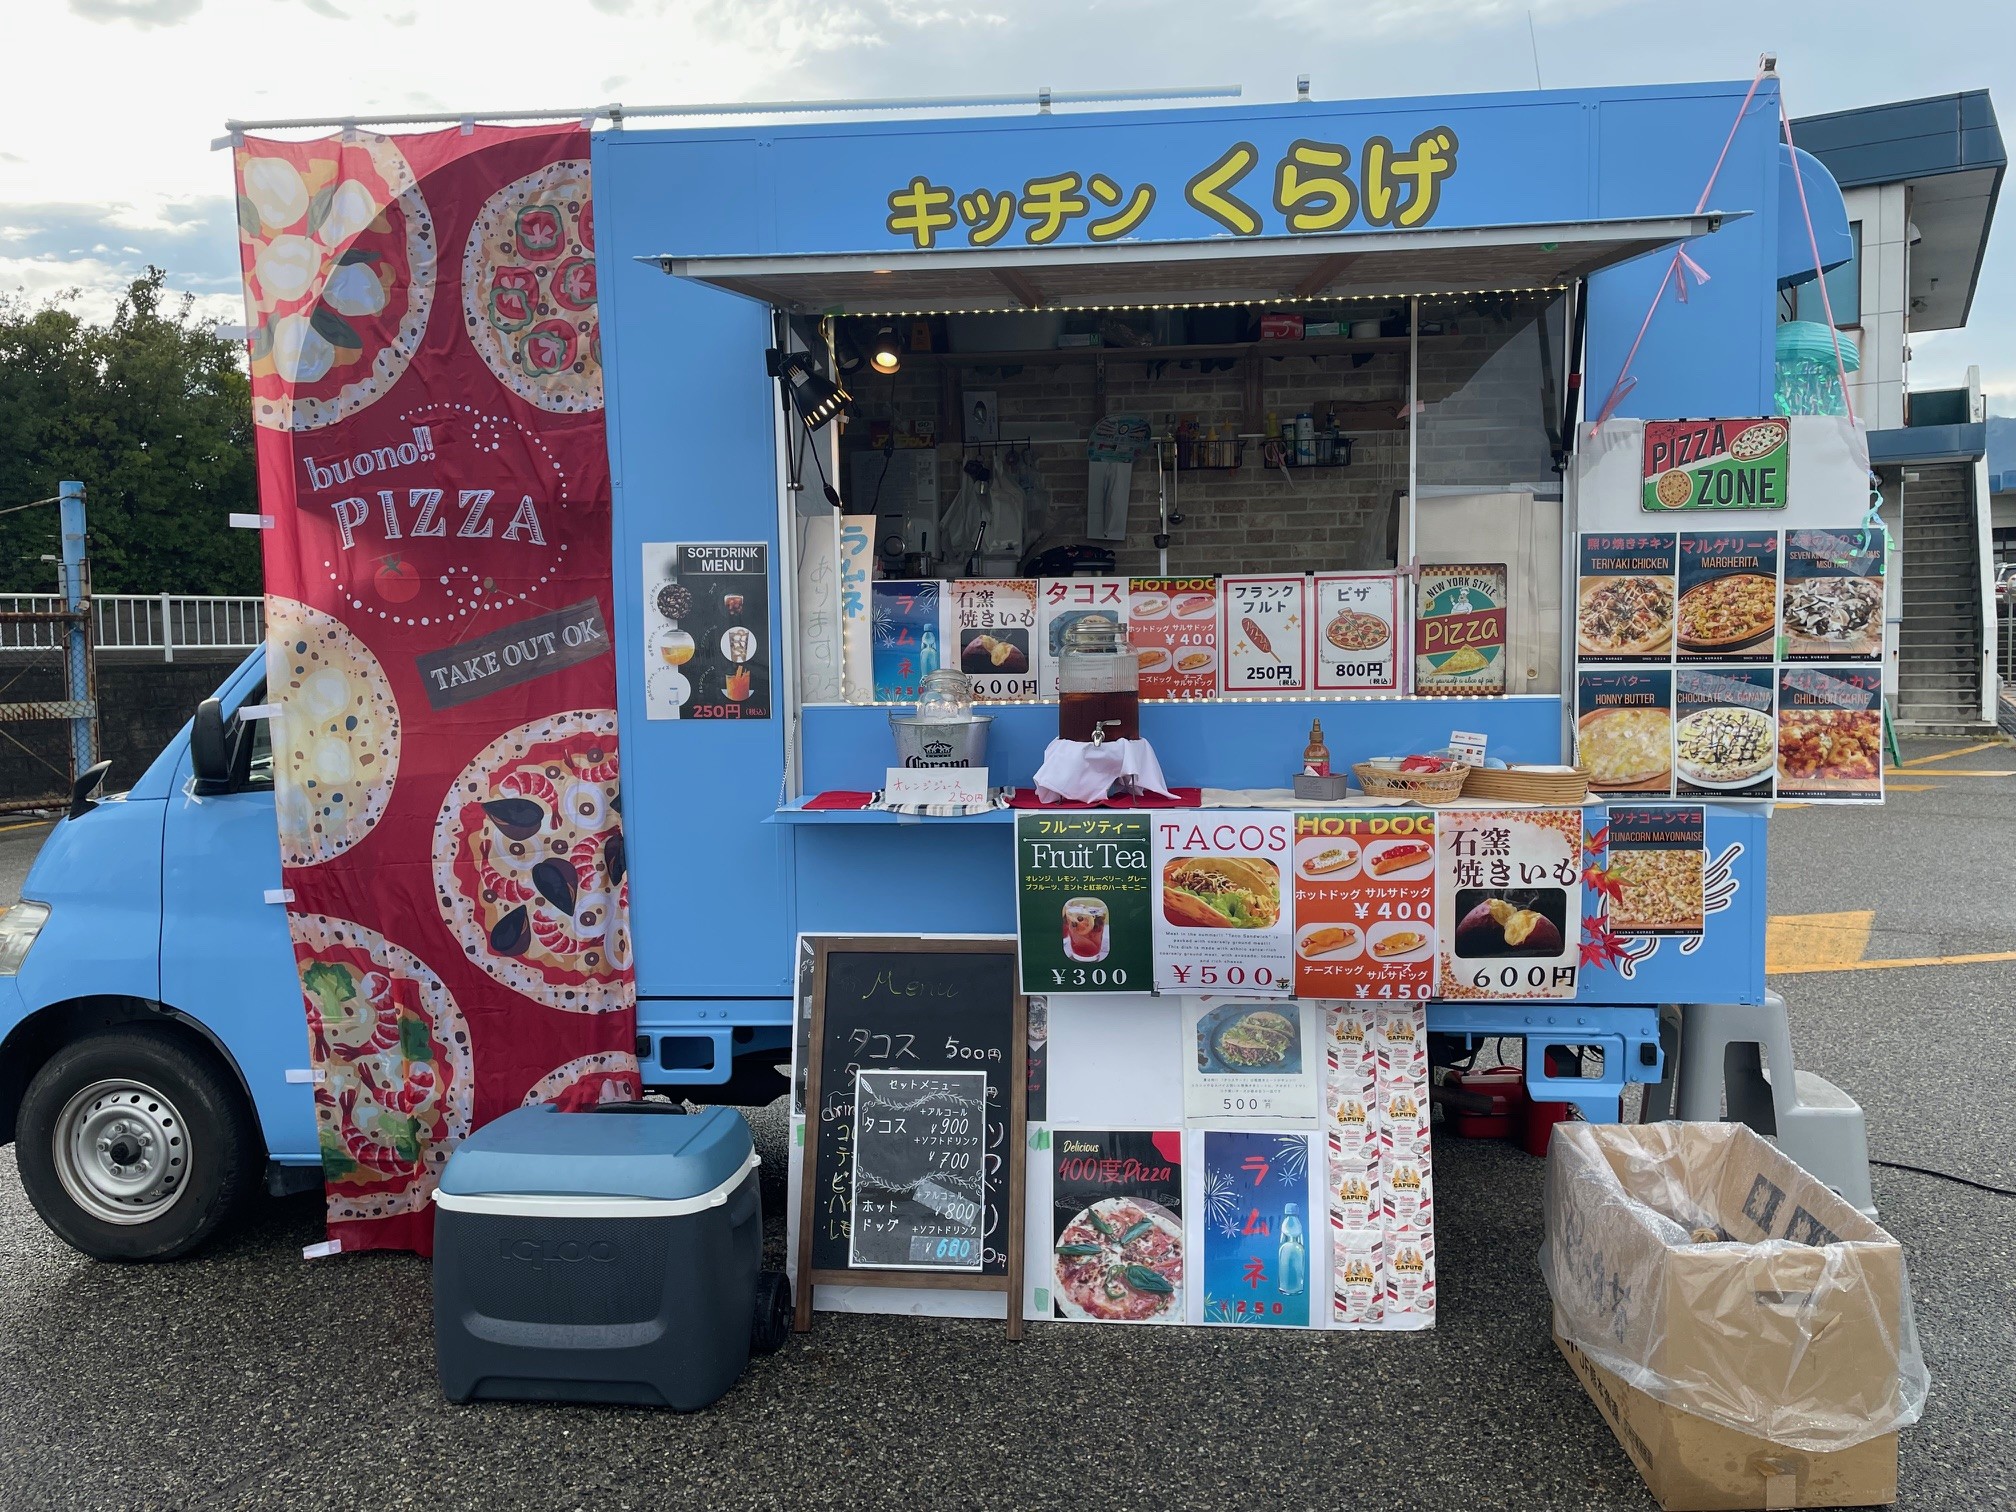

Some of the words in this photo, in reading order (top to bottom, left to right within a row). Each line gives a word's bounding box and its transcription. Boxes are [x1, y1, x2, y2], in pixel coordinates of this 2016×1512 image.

[887, 171, 1156, 249] キッチン
[1185, 125, 1459, 237] くらげ
[1652, 424, 1726, 474] PIZZA
[304, 426, 435, 491] buono!!
[1697, 467, 1777, 506] ZONE
[331, 488, 547, 550] PIZZA
[687, 547, 759, 559] SOFTDRINK
[1680, 539, 1777, 555] マルゲリータ
[1591, 558, 1630, 570] TERIYAKI
[1632, 557, 1669, 569] CHICKEN
[1700, 556, 1759, 568] MARGHERITA
[1789, 551, 1811, 560] SEVEN
[701, 559, 744, 572] MENU
[1129, 578, 1171, 591] HOT
[1235, 585, 1294, 599] フランク
[1426, 582, 1445, 599] NEW
[1446, 577, 1470, 588] YORK
[1472, 578, 1498, 598] STYLE
[956, 590, 995, 608] 石窯
[1046, 582, 1122, 605] タコス
[1337, 586, 1370, 602] ピザ
[1243, 600, 1287, 614] フルト
[958, 608, 1035, 628] 焼きいも
[1172, 624, 1215, 632] サルサドッグ
[896, 596, 915, 679] ラムネ
[429, 651, 501, 692] TAKE
[502, 632, 556, 668] OUT
[561, 617, 601, 649] OK
[1246, 664, 1293, 681] 250円
[1335, 662, 1383, 678] 800円
[1580, 674, 1651, 687] ハニーバター
[1595, 693, 1624, 705] HONNY
[1624, 692, 1655, 704] BUTTER
[1677, 692, 1723, 703] CHOCOLATE
[1793, 693, 1817, 705] CHILI
[692, 704, 741, 719] 250円
[1296, 816, 1362, 836] HOT
[1369, 816, 1434, 836] DOG
[1613, 812, 1701, 825] ツナコーンマヨ
[1039, 820, 1141, 835] フルーツティー
[1160, 824, 1287, 851] TACOS
[1448, 827, 1511, 857] 石窯
[1610, 831, 1651, 843] TUNACORN
[1651, 830, 1703, 842] MAYONNAISE
[1030, 843, 1094, 869] Fruit
[1095, 843, 1148, 869] Tea
[1453, 858, 1577, 889] 焼きいも
[1295, 890, 1361, 900] ホットドッグ
[1365, 887, 1431, 899] サルサドッグ
[1354, 902, 1432, 919] ¥400
[1051, 968, 1127, 985] ¥300
[1172, 964, 1273, 986] ¥500
[1303, 965, 1365, 976] チーズドッグ
[1383, 963, 1412, 972] チーズ
[1366, 970, 1428, 981] サルサドッグ
[1473, 966, 1578, 988] 600円
[862, 970, 959, 1000] Menu
[1355, 984, 1432, 1000] ¥450
[848, 1028, 920, 1060] タコス
[945, 1035, 1002, 1063] 500円
[889, 1078, 961, 1091] セットメニュー
[1223, 1098, 1258, 1110] 500
[864, 1118, 907, 1134] タコス
[1063, 1139, 1100, 1153] Delicious
[862, 1200, 898, 1214] ホット
[862, 1218, 899, 1233] ドッグ
[1241, 1156, 1270, 1289] ラムネ
